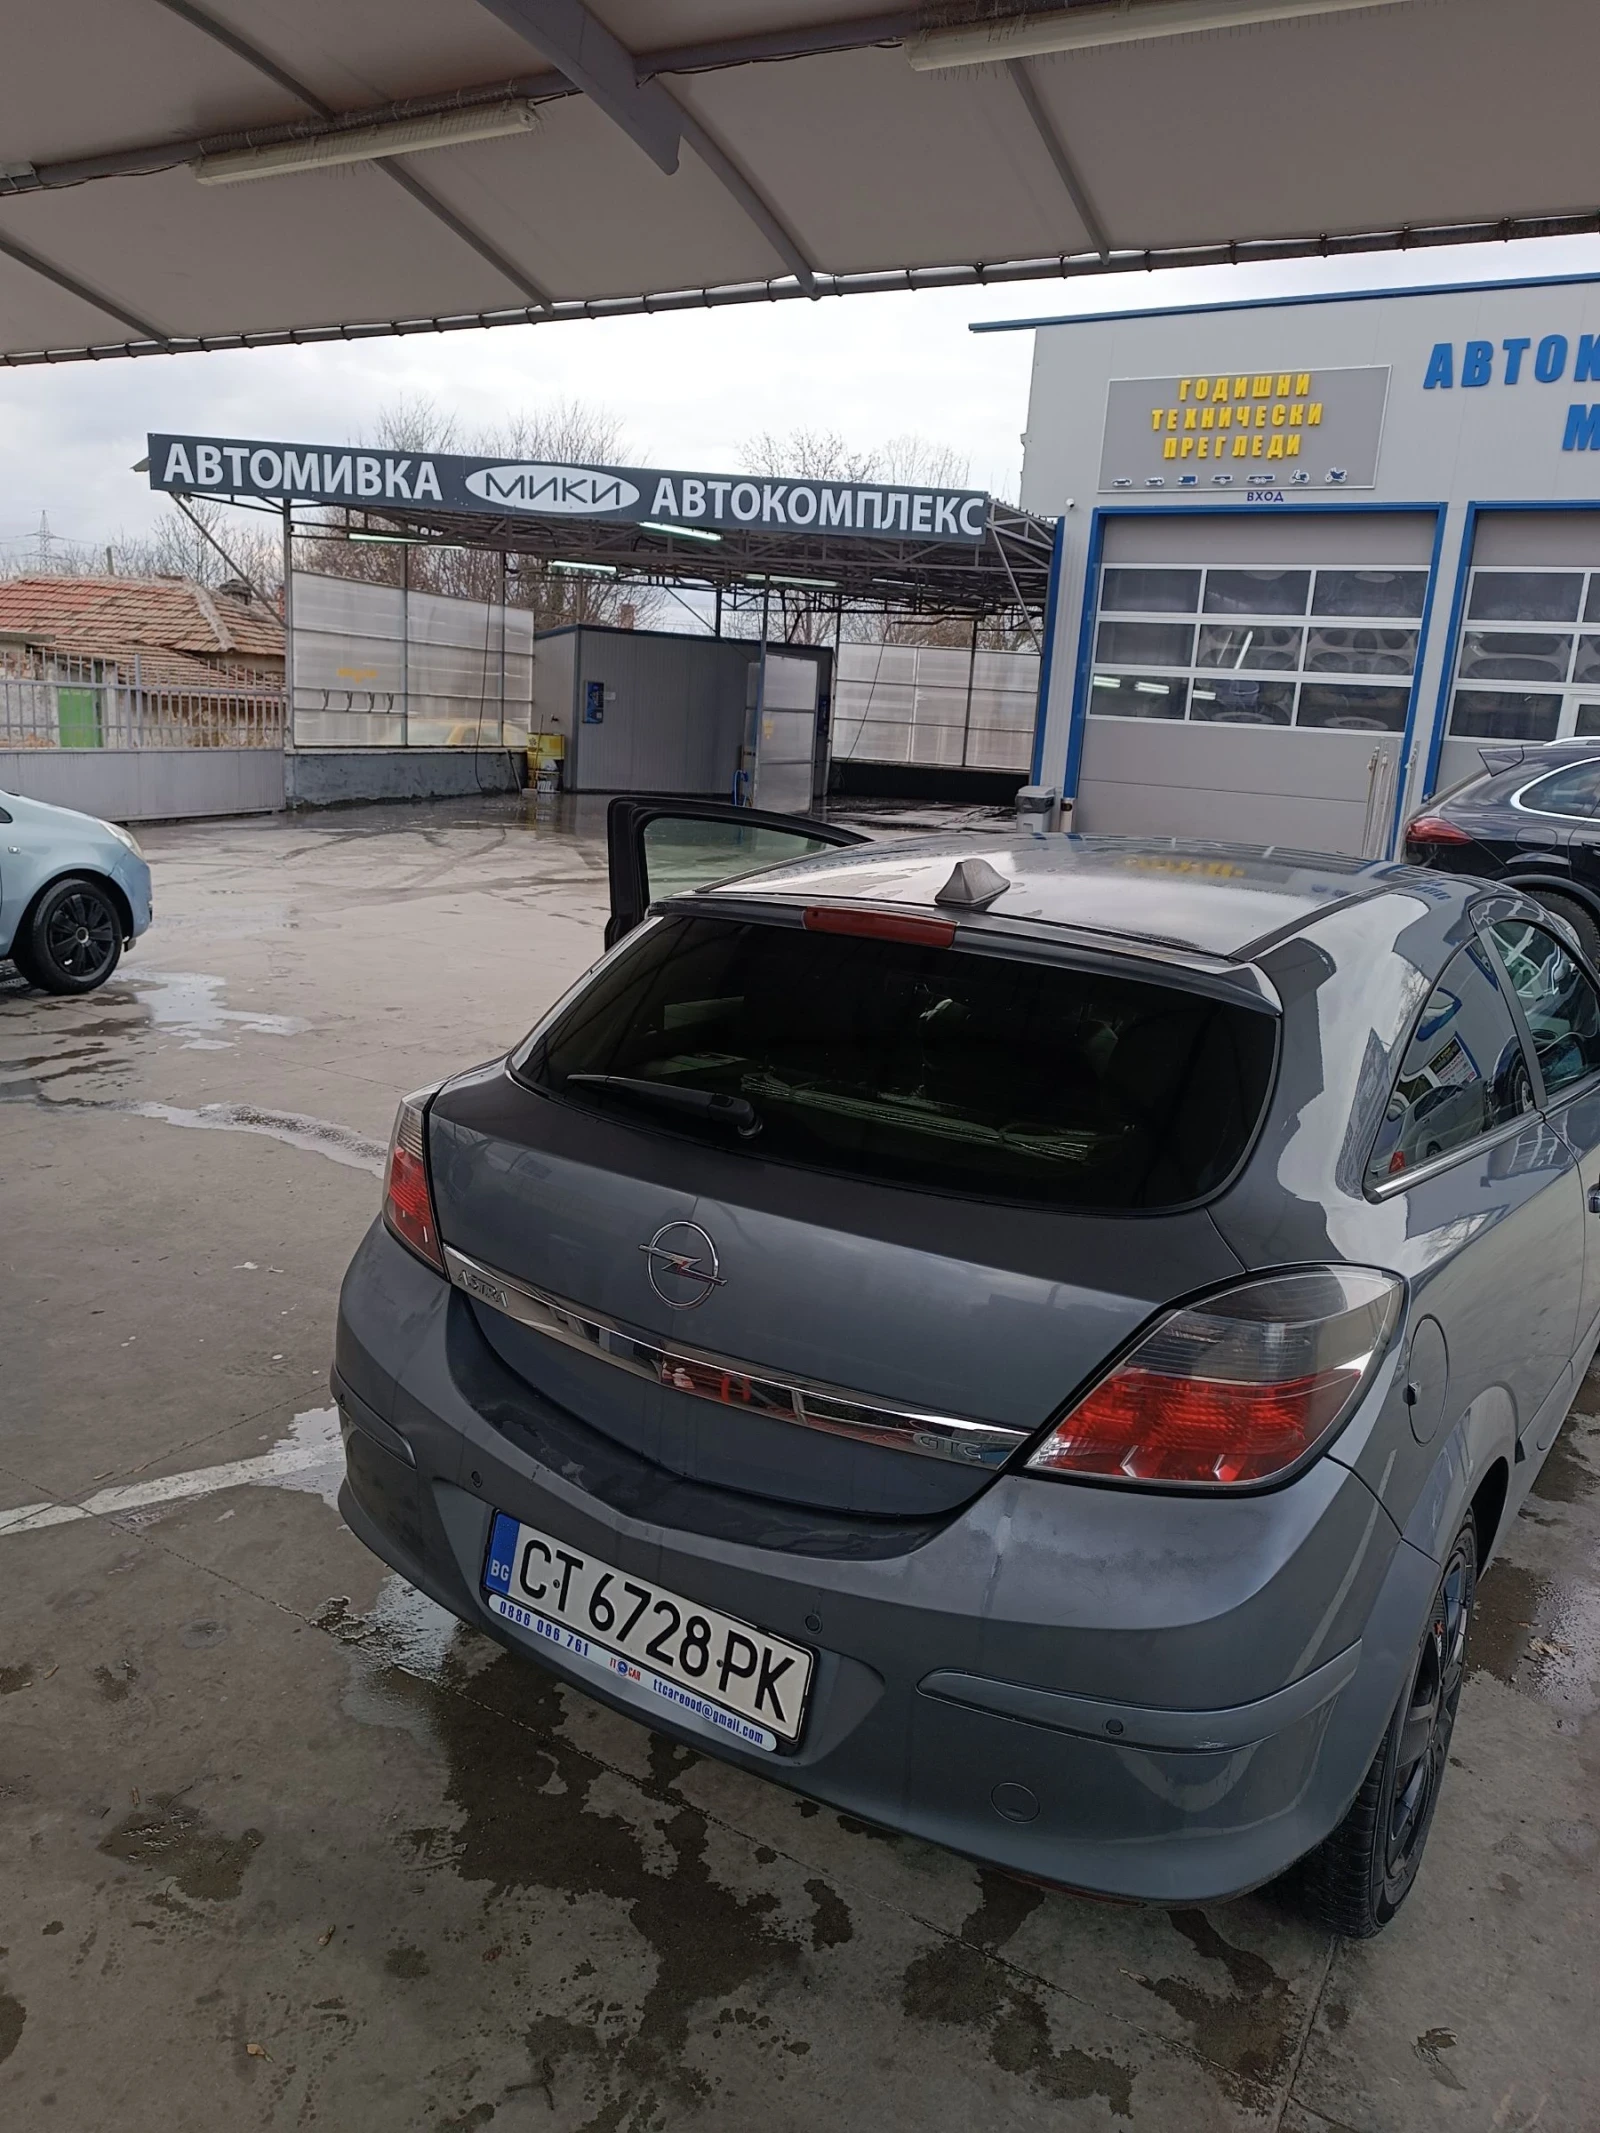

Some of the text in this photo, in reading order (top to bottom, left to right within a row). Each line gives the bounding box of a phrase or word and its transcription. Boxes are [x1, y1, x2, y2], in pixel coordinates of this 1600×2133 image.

[1179, 373, 1310, 402] ГОДИШНИ
[1151, 403, 1323, 430] ТЕХНИЧЕСКИ
[1163, 434, 1301, 459] ПРЕГЛЕДИ
[163, 442, 986, 537] АВТОМИВКА МИКИ АВТОКОМПЛЕКС
[1247, 491, 1284, 502] ВХОД
[913, 1432, 982, 1462] GTC
[490, 1559, 510, 1582] BG
[500, 1600, 589, 1657] 0886 086 761
[589, 1573, 711, 1677] 6728
[628, 1667, 641, 1681] CAR
[653, 1679, 763, 1744] ttcareood@gmail.com
